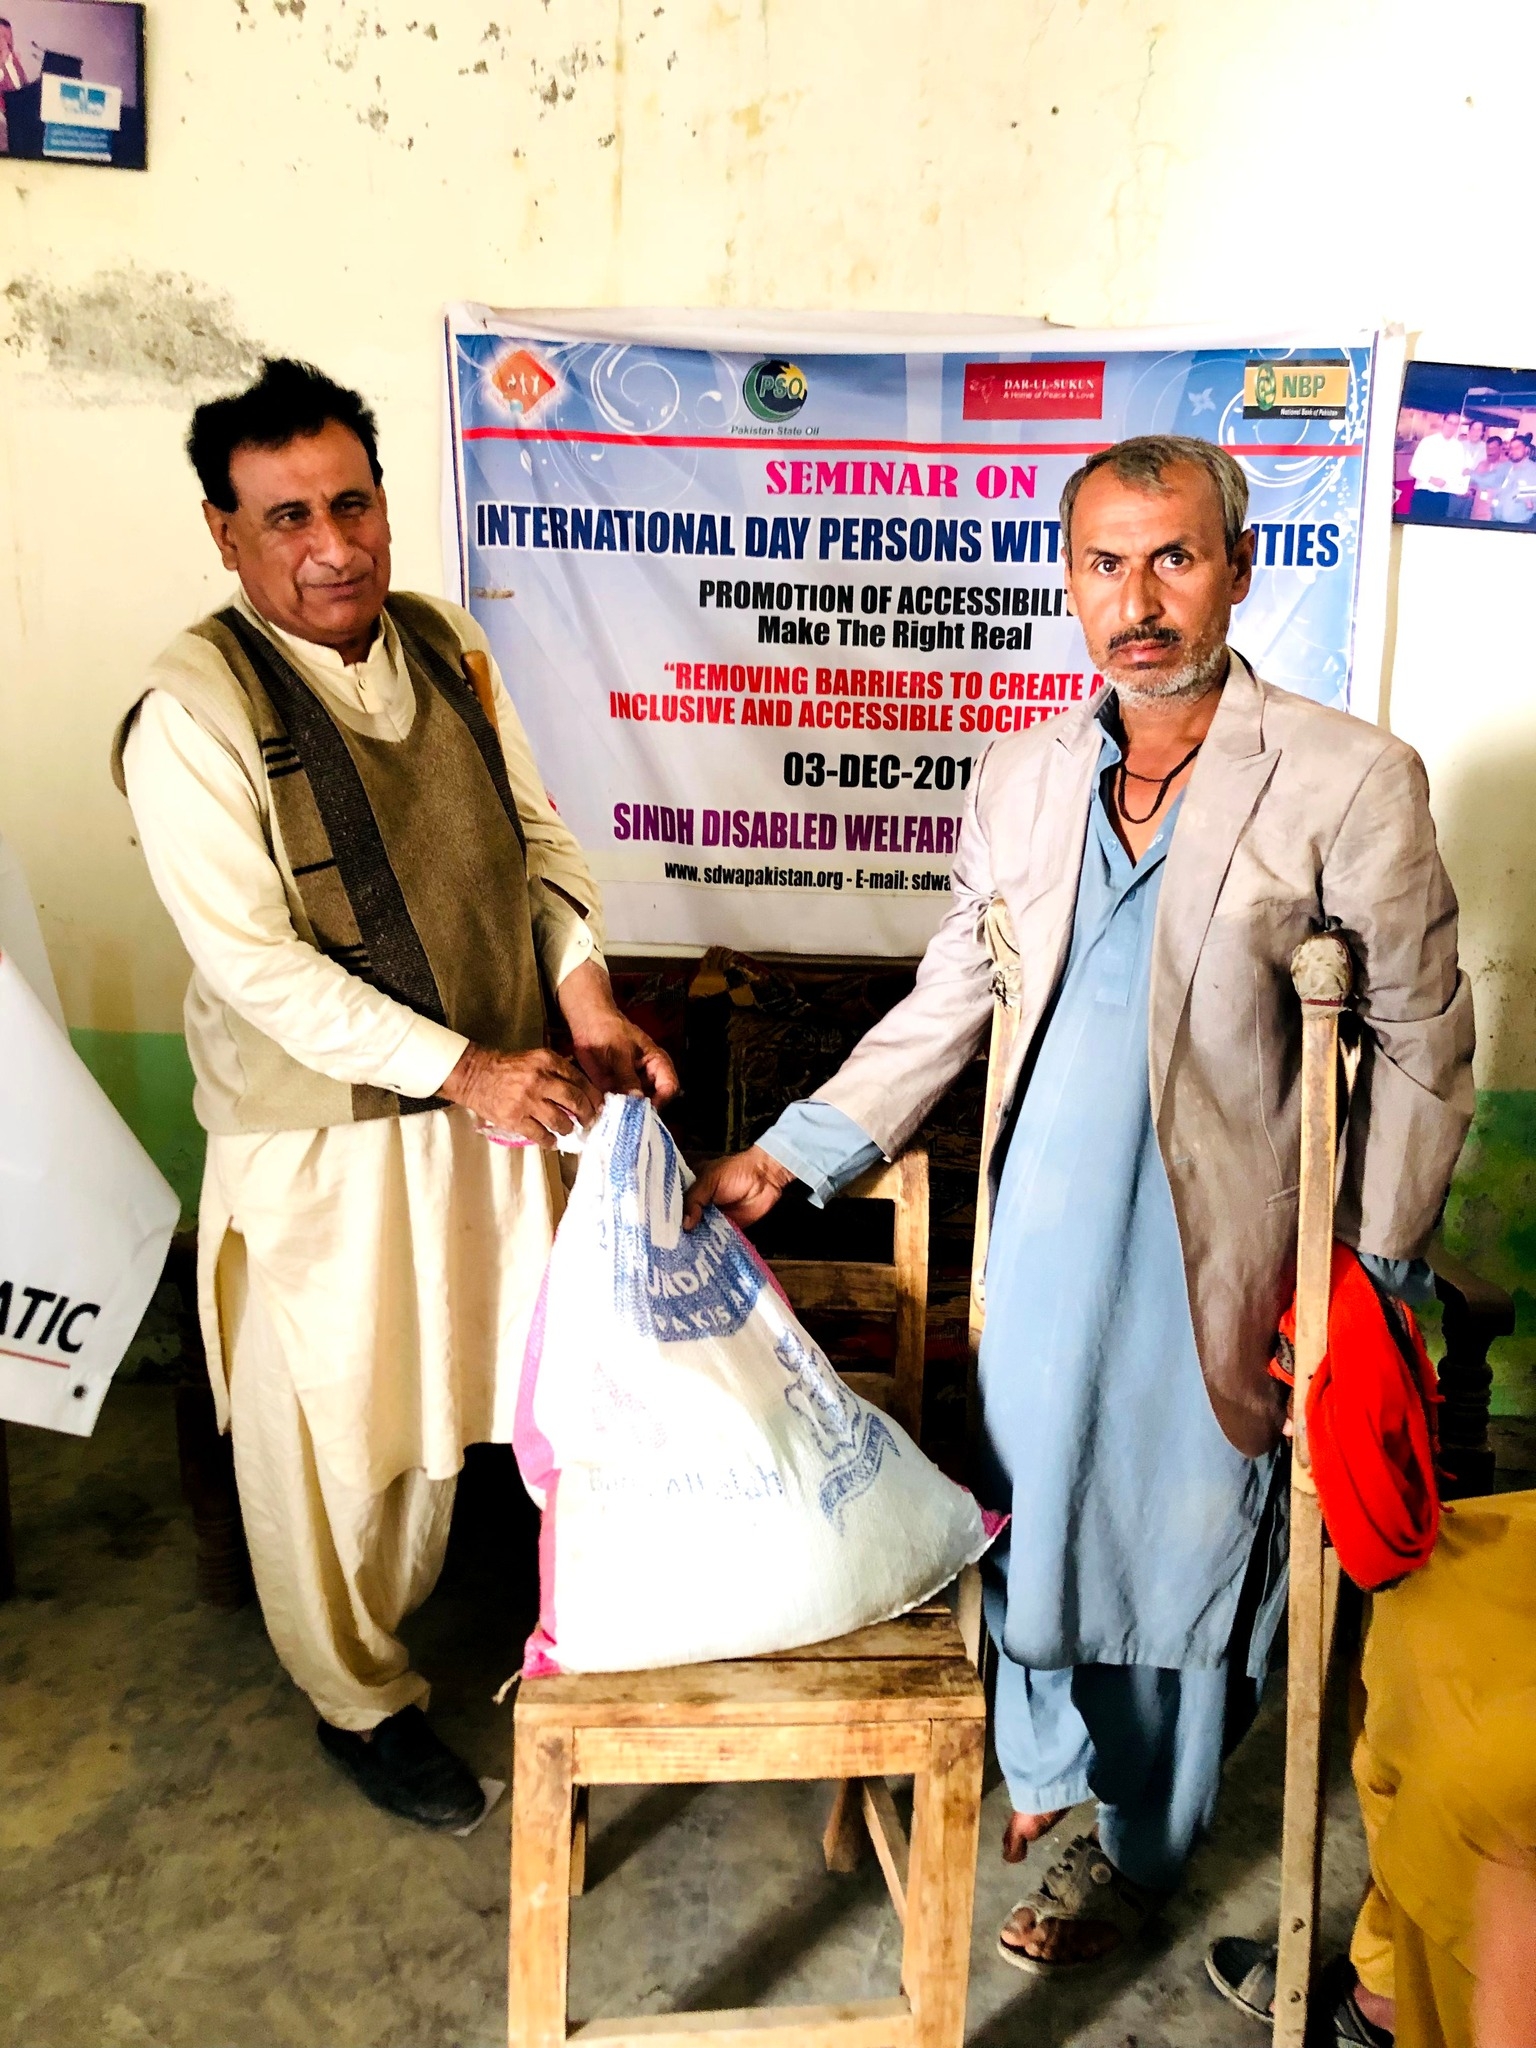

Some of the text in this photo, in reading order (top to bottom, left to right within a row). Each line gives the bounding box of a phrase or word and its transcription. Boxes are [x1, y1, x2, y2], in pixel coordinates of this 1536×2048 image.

[759, 374, 803, 399] PSO
[1011, 391, 1032, 399] Home
[1282, 374, 1326, 398] NBP
[1281, 408, 1300, 416] National
[1301, 408, 1313, 416] Bank
[1319, 408, 1338, 416] Pakistan
[731, 425, 820, 436] Pakistan State Oil
[766, 461, 1038, 499] SEMINAR ON
[477, 504, 1340, 568] INTERNATIONAL DAY PERSONS WIT ITIES
[699, 580, 1072, 616] PROMOTION OF ACCESSIBILI
[757, 615, 1032, 652] Make The Right Real
[816, 669, 943, 699] BARRIERS
[951, 672, 982, 701] TO
[989, 673, 1083, 701] CREATE
[609, 692, 735, 724] INCLUSIVE
[741, 698, 792, 726] AND
[799, 701, 952, 732] ACCESSIBLE
[784, 751, 977, 791] 03-DEC-201
[613, 803, 694, 845] SINDH
[702, 809, 837, 851] DISABLED
[704, 864, 843, 890] sdwapakistan.org
[855, 870, 908, 890] E-mail:
